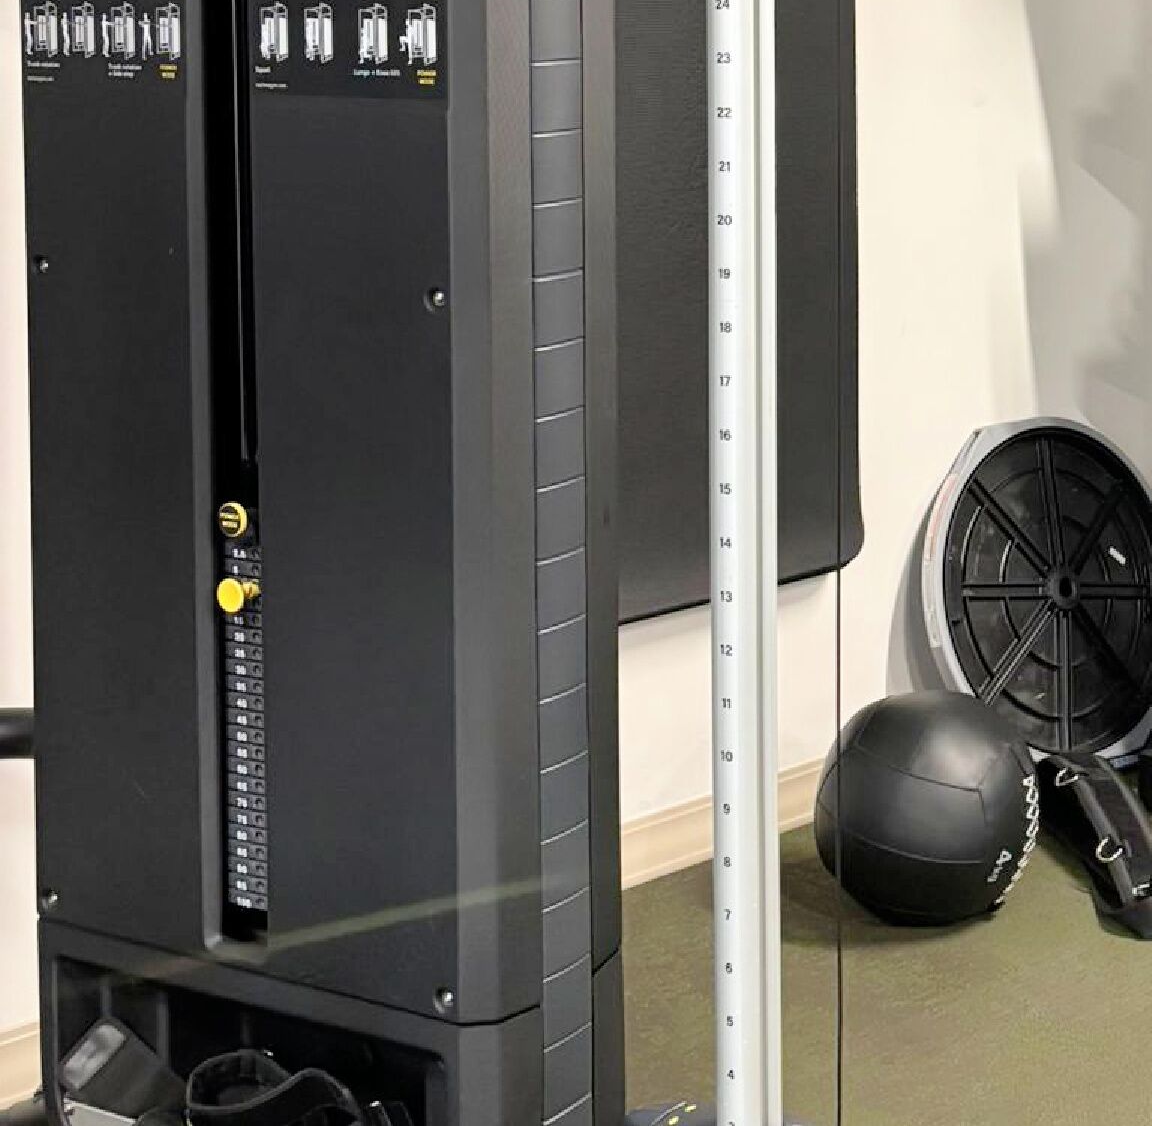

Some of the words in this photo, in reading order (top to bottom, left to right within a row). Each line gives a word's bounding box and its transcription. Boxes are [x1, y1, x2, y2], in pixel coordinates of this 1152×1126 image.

[716, 51, 731, 65] 23
[716, 106, 733, 119] 22
[719, 160, 731, 173] 21
[717, 214, 733, 226] 20
[719, 320, 733, 334] 18
[719, 374, 731, 387] 17
[719, 428, 733, 442] 16
[719, 482, 733, 496] 15
[719, 536, 733, 549] 14
[720, 590, 733, 603] 13
[720, 643, 733, 657] 12
[722, 697, 731, 709] 11
[720, 749, 734, 763] 10
[723, 803, 731, 816] 9
[723, 856, 733, 868] 8
[724, 908, 731, 921] 7
[725, 962, 733, 975] 6
[726, 1015, 734, 1027] 5
[726, 1069, 736, 1081] 4
